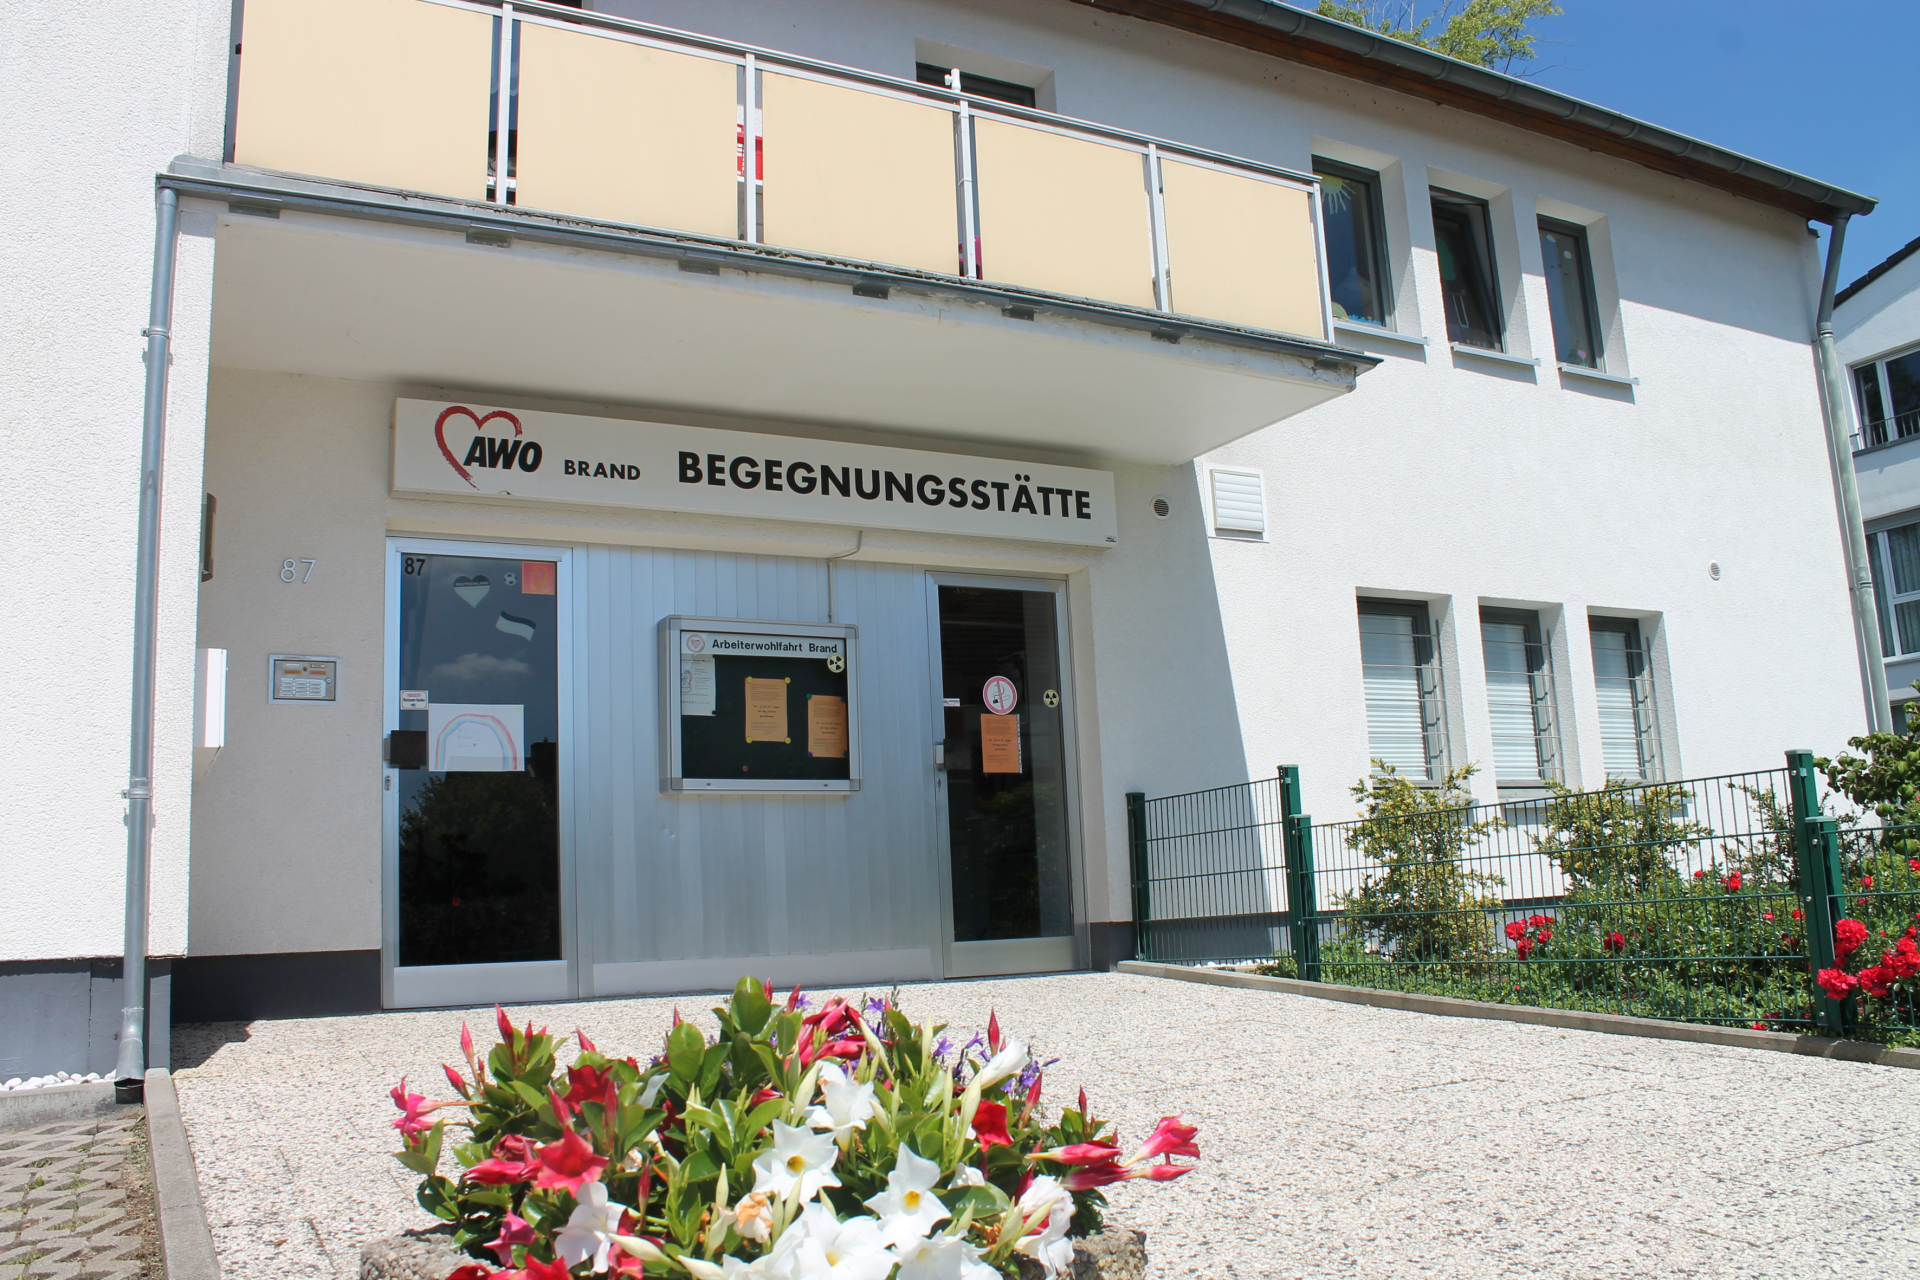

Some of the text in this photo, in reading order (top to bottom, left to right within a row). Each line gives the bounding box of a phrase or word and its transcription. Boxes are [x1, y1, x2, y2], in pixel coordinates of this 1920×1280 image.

[463, 435, 543, 473] AWO
[563, 450, 1092, 520] BRAND BEGEGNUNGSSTÄTTE
[280, 558, 317, 583] 87
[404, 557, 426, 577] 87
[712, 639, 838, 653] Arbeiterwohlfahrt Brand
